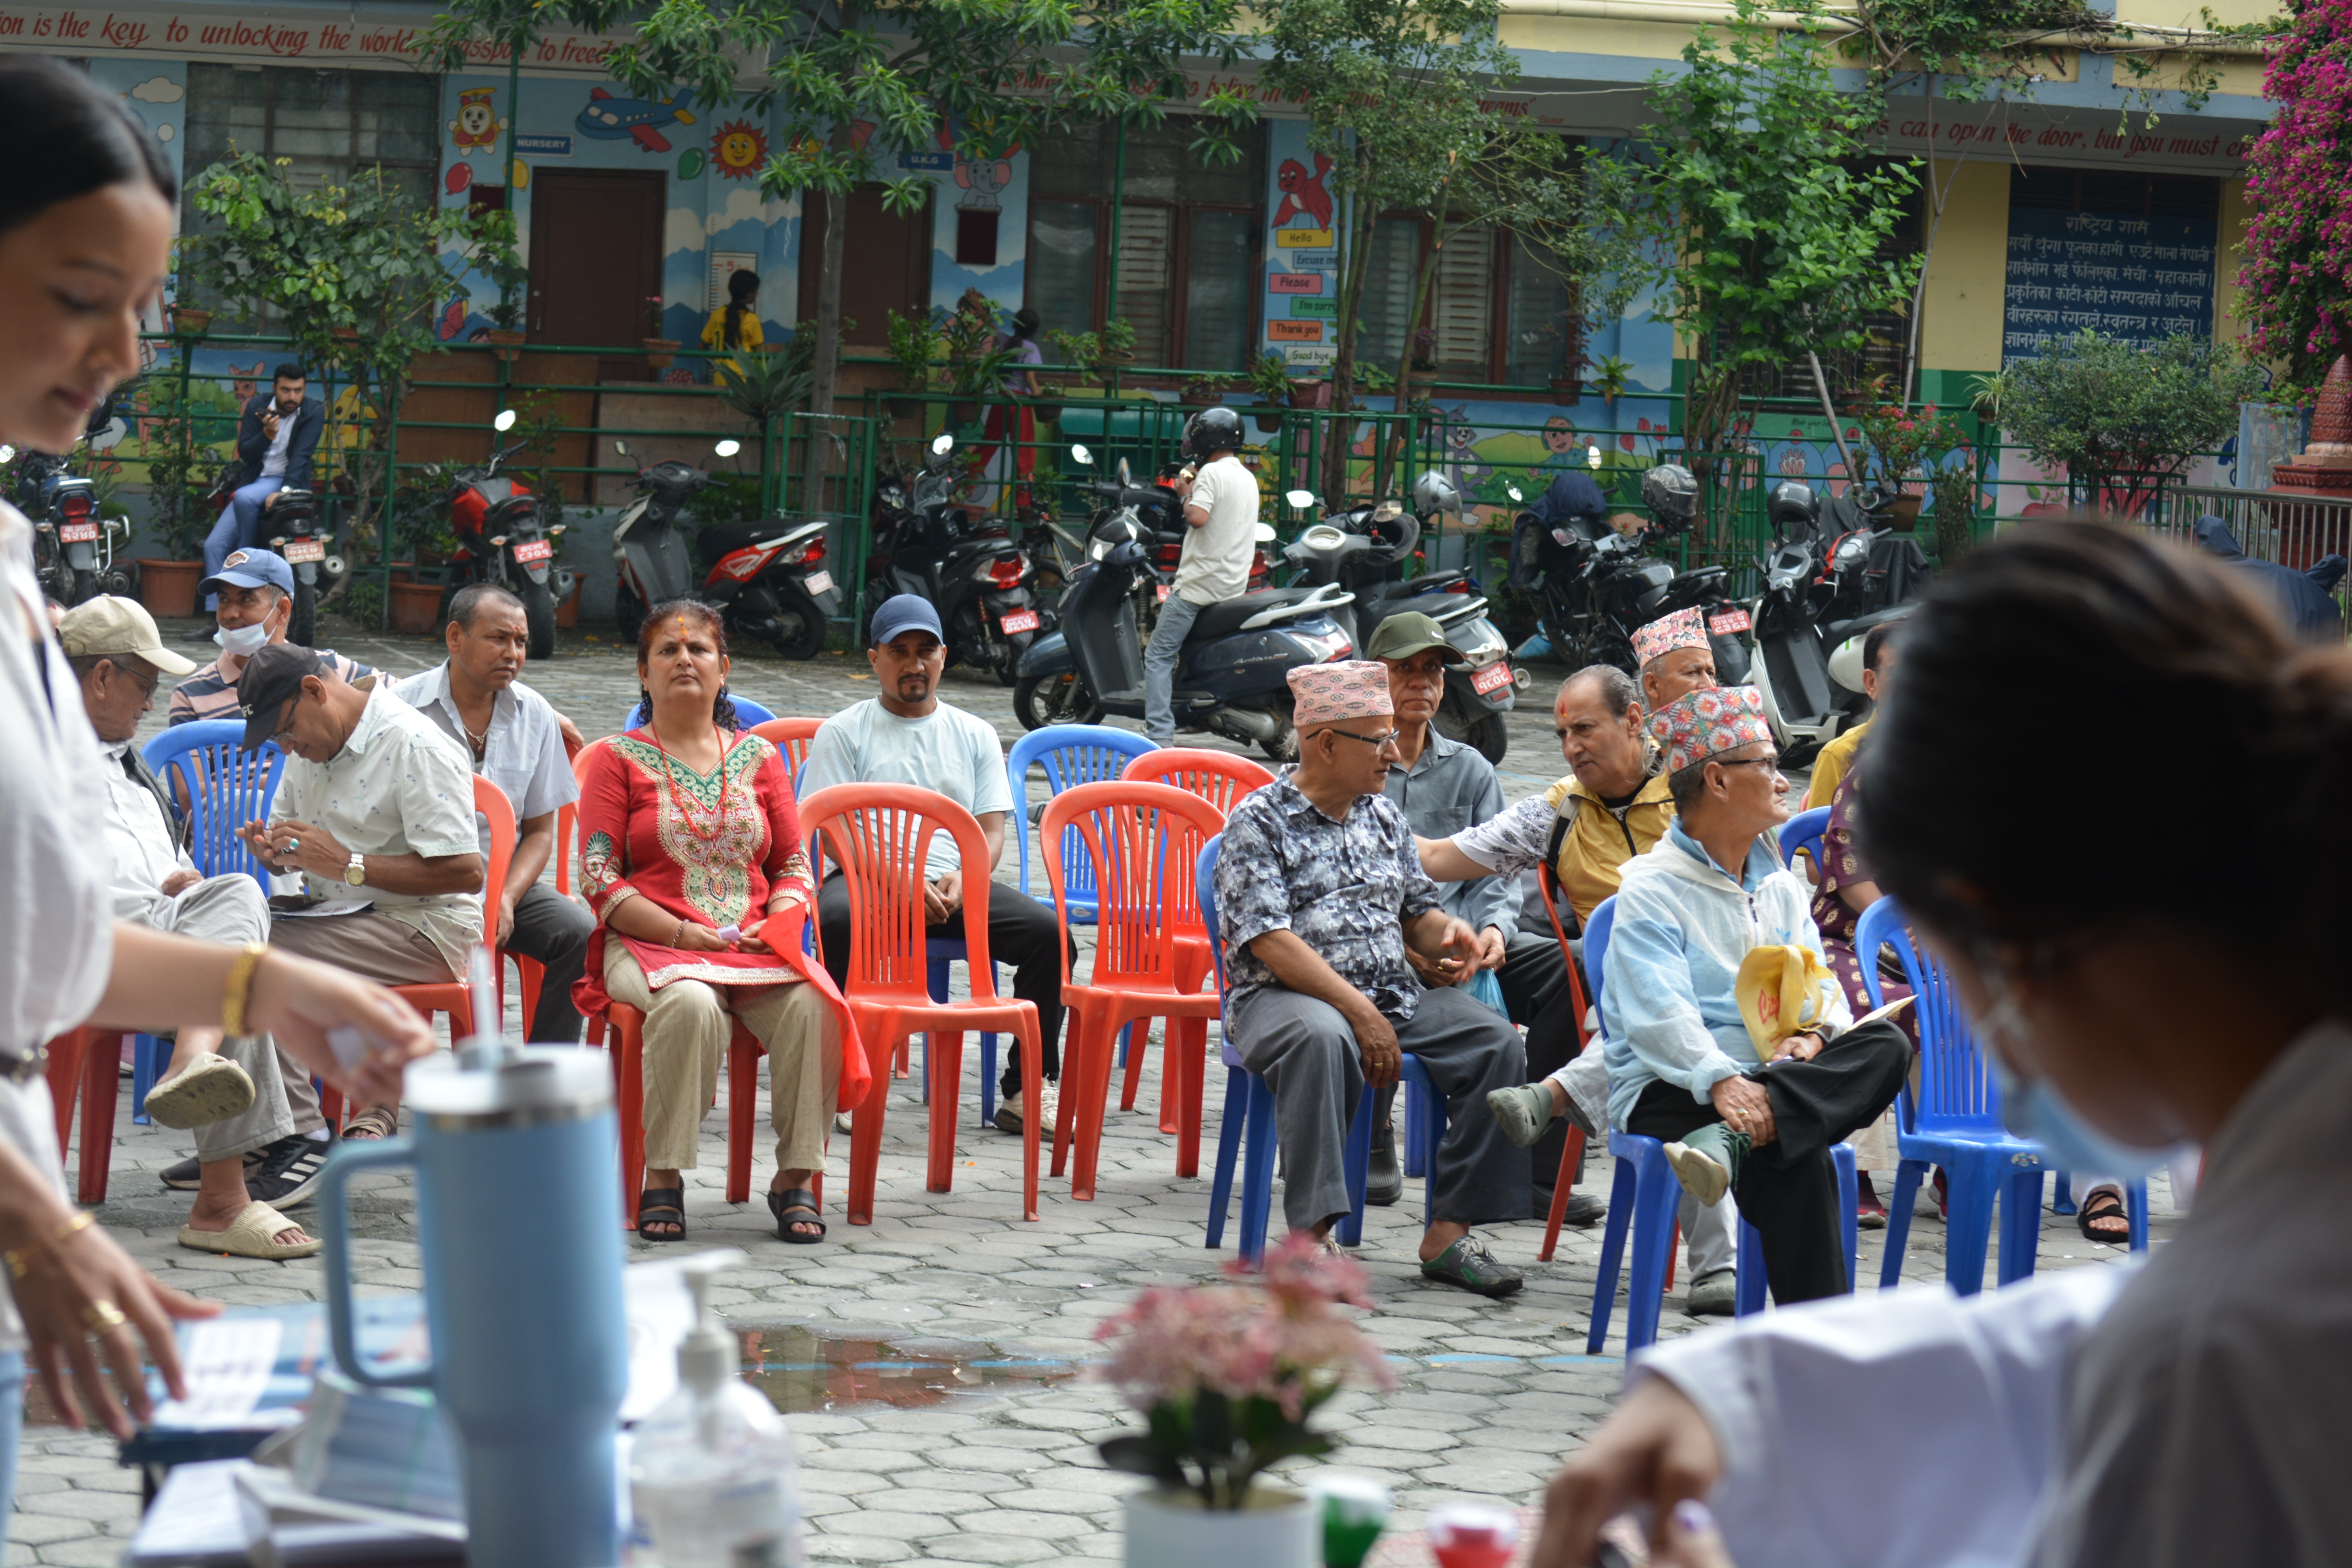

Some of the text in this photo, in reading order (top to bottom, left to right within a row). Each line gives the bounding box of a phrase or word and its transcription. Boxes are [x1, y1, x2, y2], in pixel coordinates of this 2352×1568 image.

[33, 12, 51, 36] is
[58, 11, 90, 38] the
[101, 14, 149, 48] key
[166, 16, 189, 42] to
[200, 20, 309, 56] unlocking
[319, 25, 351, 50] the
[537, 38, 556, 61] to
[517, 139, 566, 148] NURSERY
[1900, 120, 1938, 139] can
[1949, 123, 1996, 145] open
[2003, 123, 2032, 144] the
[2038, 125, 2087, 150] door,
[2124, 135, 2161, 158] you
[2168, 135, 2220, 156] must
[1289, 233, 1312, 242] Hello
[2100, 240, 2124, 262] हामी
[1297, 255, 1324, 265] Excuse
[1280, 277, 1310, 287] Please
[1299, 299, 1312, 310] I'm
[1276, 323, 1319, 338] Thank you
[1314, 351, 1329, 364] bye
